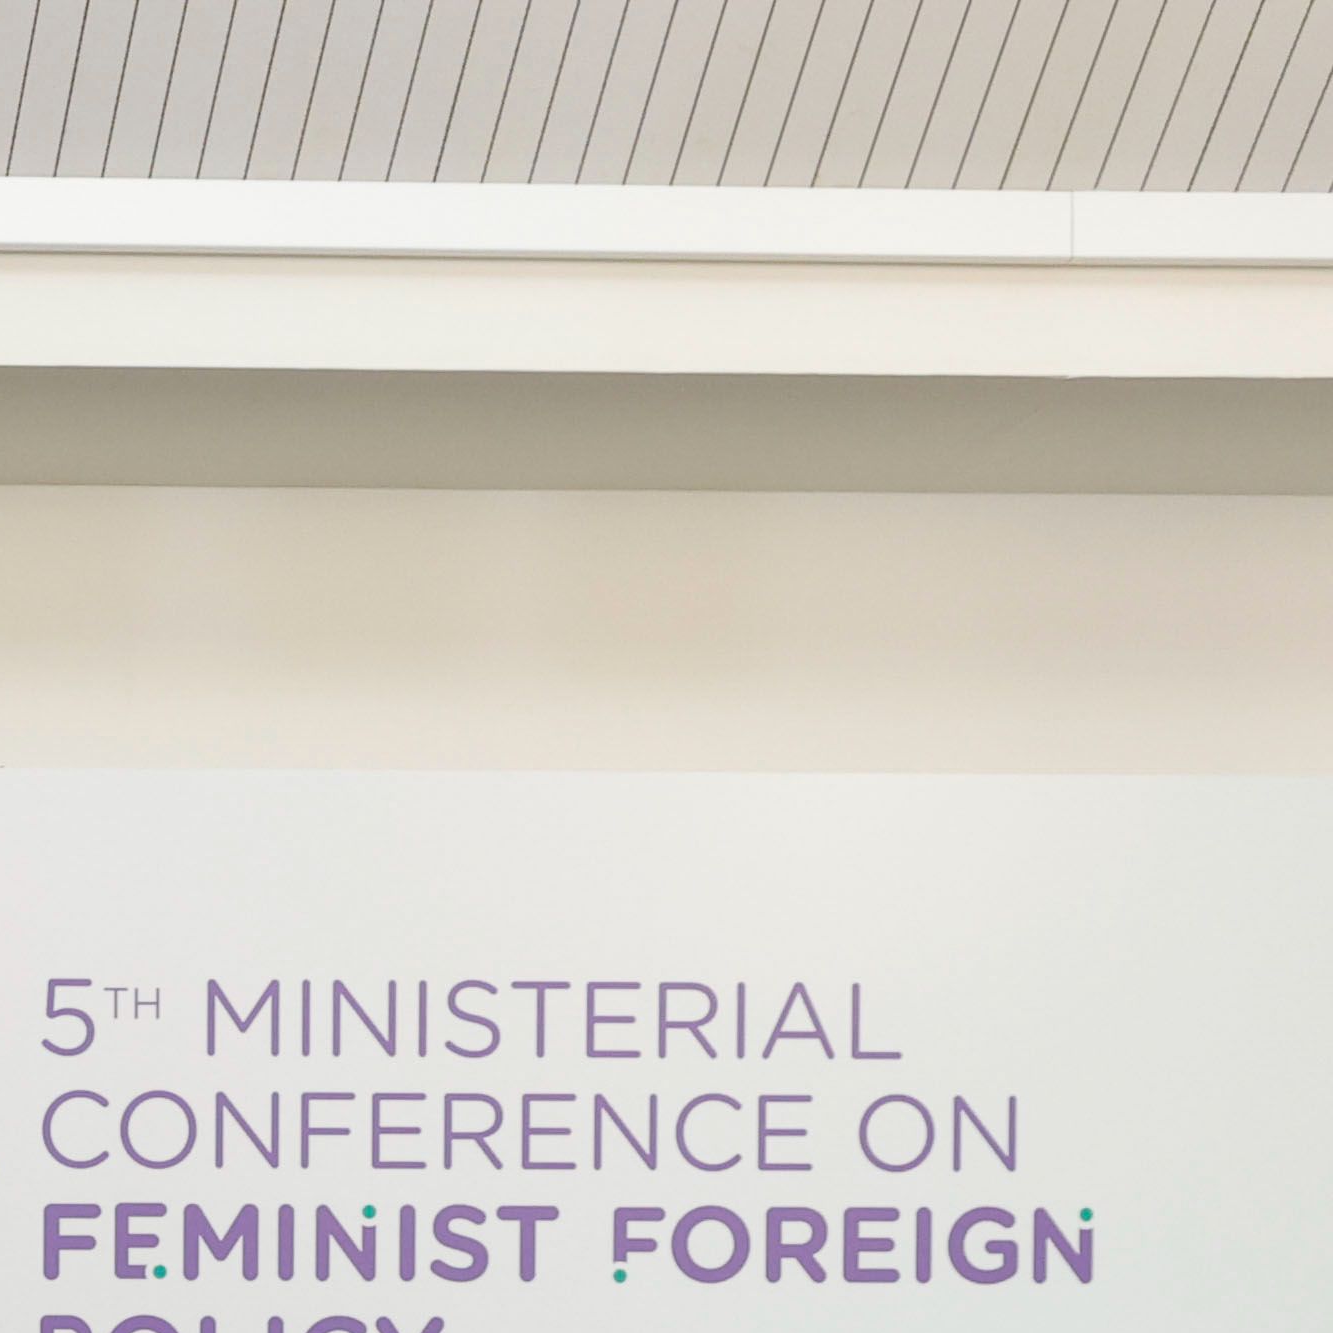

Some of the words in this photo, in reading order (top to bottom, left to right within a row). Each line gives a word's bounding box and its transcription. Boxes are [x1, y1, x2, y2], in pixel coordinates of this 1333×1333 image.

[41, 978, 161, 1057] 5TH
[207, 979, 902, 1060] MINISTERIAL
[42, 1090, 811, 1173] CONFERENCE
[859, 1095, 1017, 1172] ON
[44, 1202, 559, 1283] FEMINIST
[612, 1205, 1094, 1285] FOREIGN
